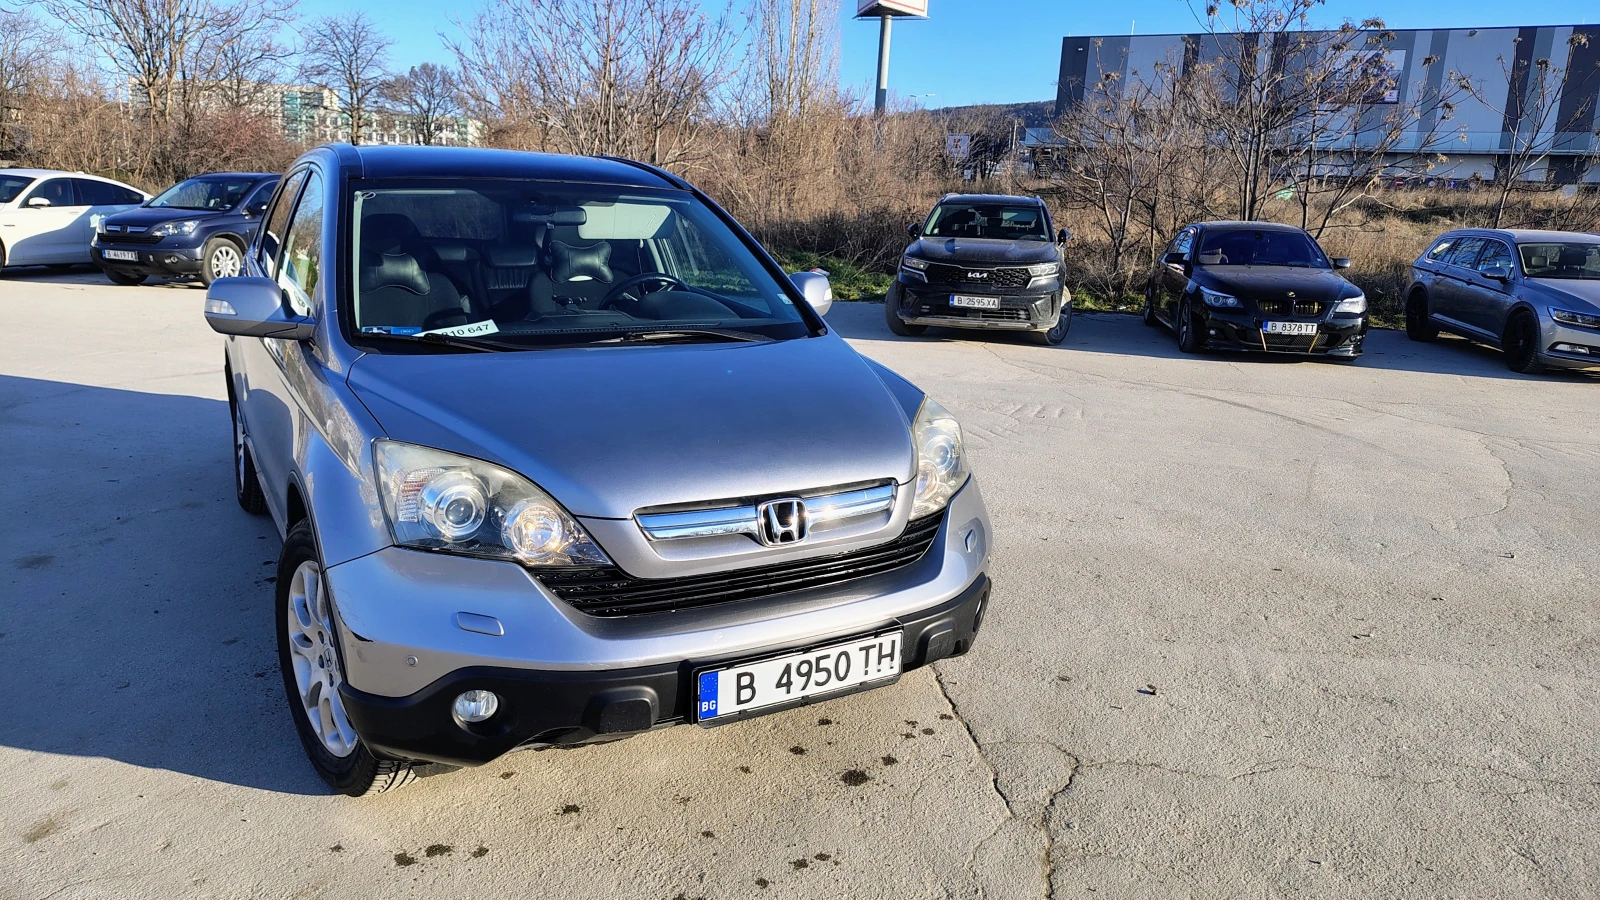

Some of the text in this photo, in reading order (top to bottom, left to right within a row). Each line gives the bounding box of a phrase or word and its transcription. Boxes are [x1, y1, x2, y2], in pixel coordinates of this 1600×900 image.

[957, 297, 963, 305] B
[966, 298, 985, 306] 2595
[986, 299, 997, 307] XA
[467, 324, 489, 333] 647
[1271, 323, 1278, 331] B
[1281, 323, 1303, 332] 8378
[1304, 324, 1316, 333] TT
[736, 639, 897, 706] B 4950 TH
[701, 699, 717, 712] BG
